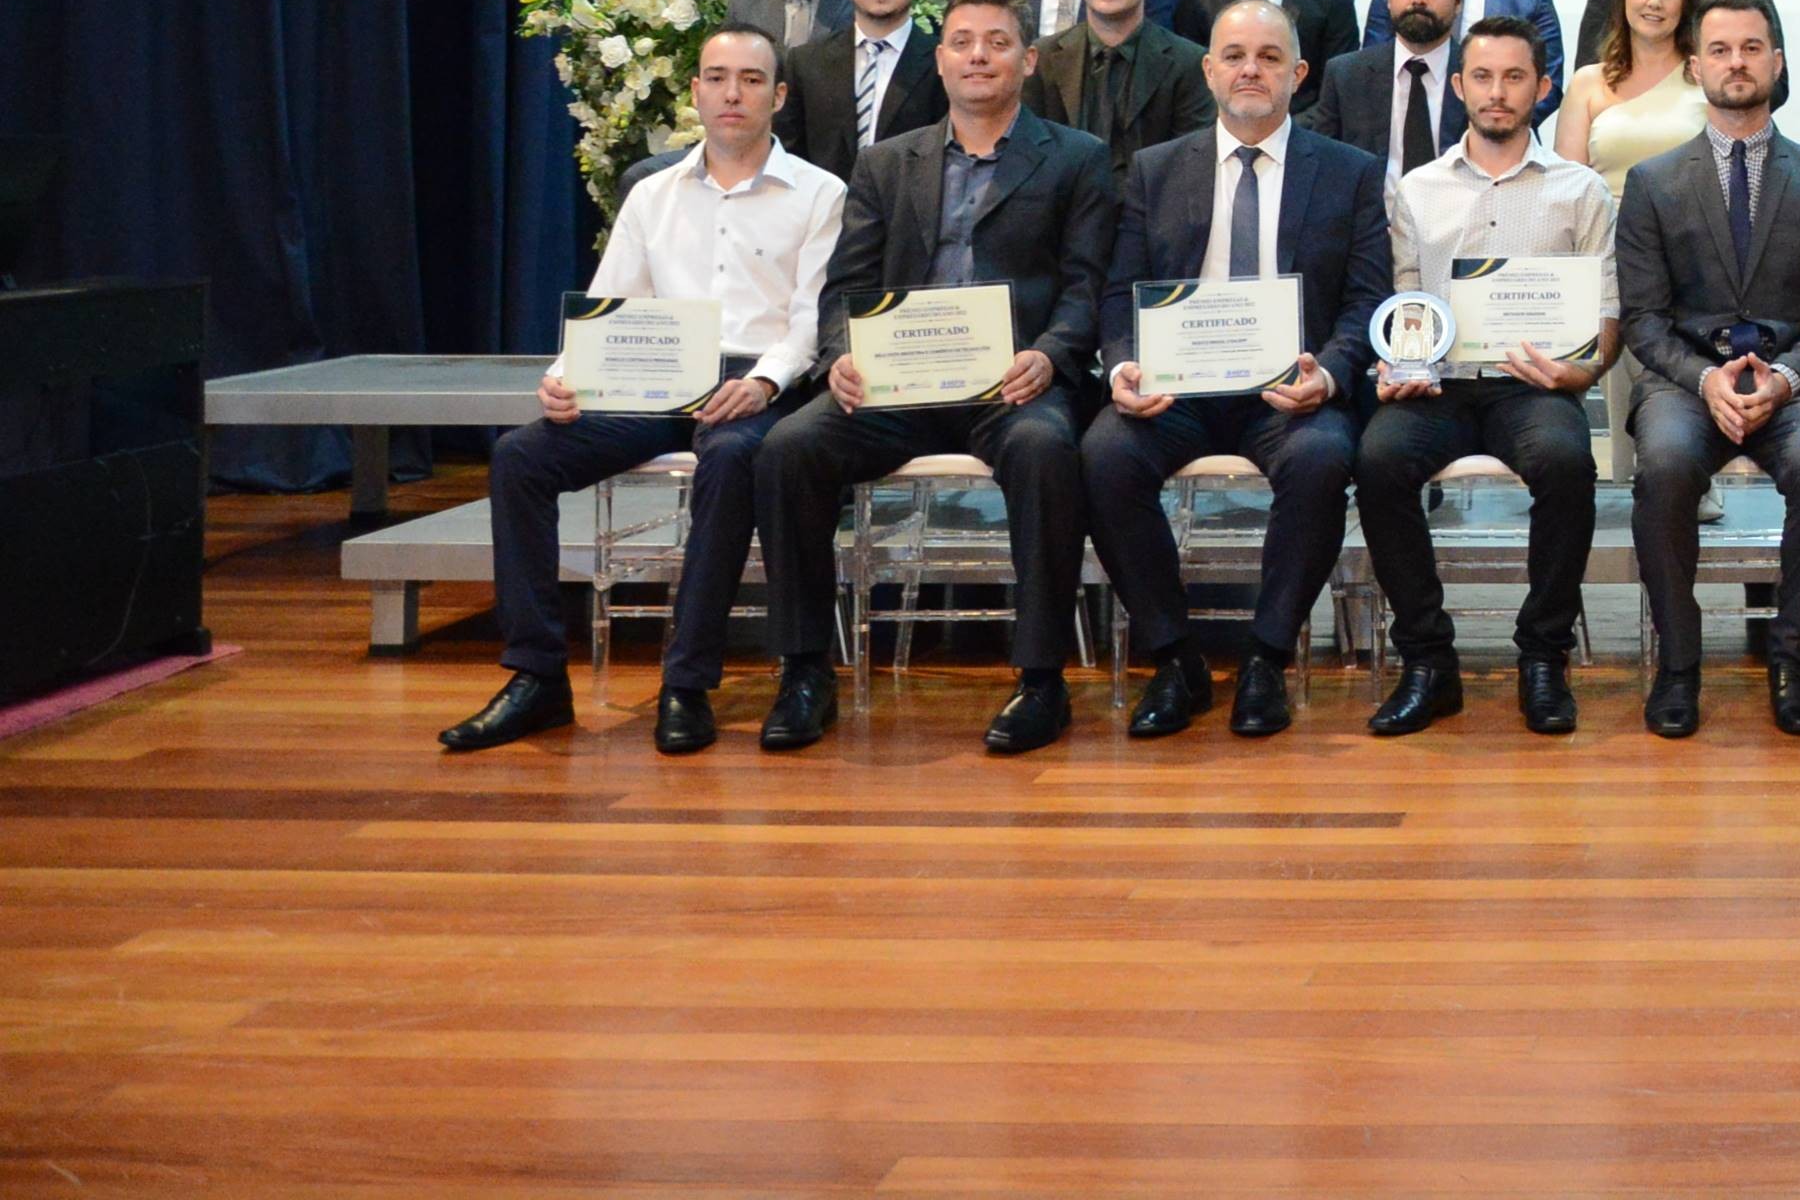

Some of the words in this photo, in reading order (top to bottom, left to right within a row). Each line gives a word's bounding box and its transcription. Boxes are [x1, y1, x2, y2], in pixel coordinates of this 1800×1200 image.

[1489, 291, 1561, 301] CERTIFICADO
[1182, 316, 1257, 329] CERTIFICADO
[893, 326, 969, 339] CERTIFICADO
[605, 335, 681, 345] CERTIFICADO
